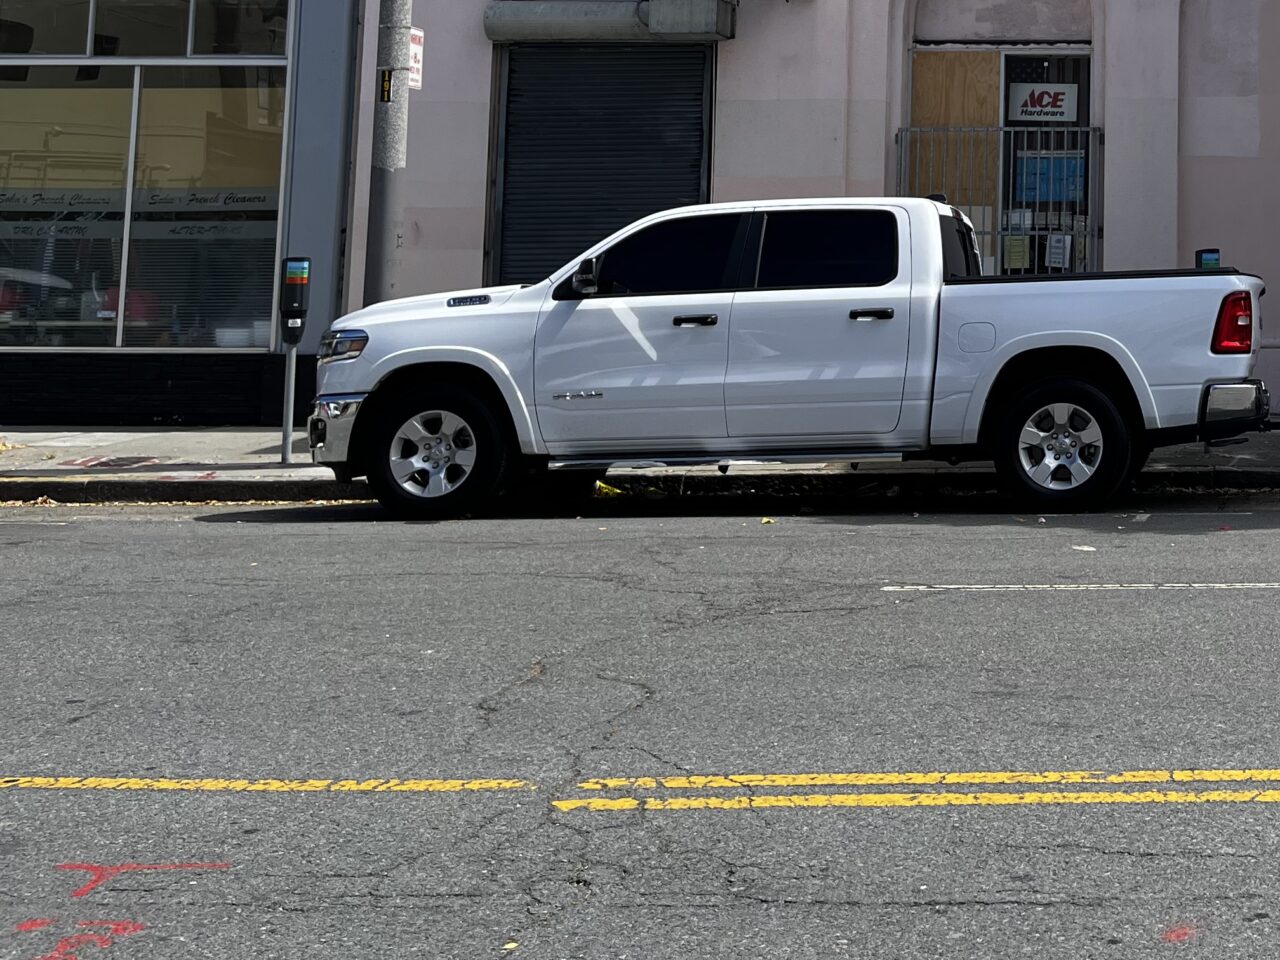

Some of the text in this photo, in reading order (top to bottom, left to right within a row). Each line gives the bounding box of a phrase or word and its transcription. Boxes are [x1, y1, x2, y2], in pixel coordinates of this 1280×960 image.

[1020, 89, 1066, 109] ACE
[1020, 109, 1065, 117] Hardware
[223, 192, 267, 206] Cleaners
